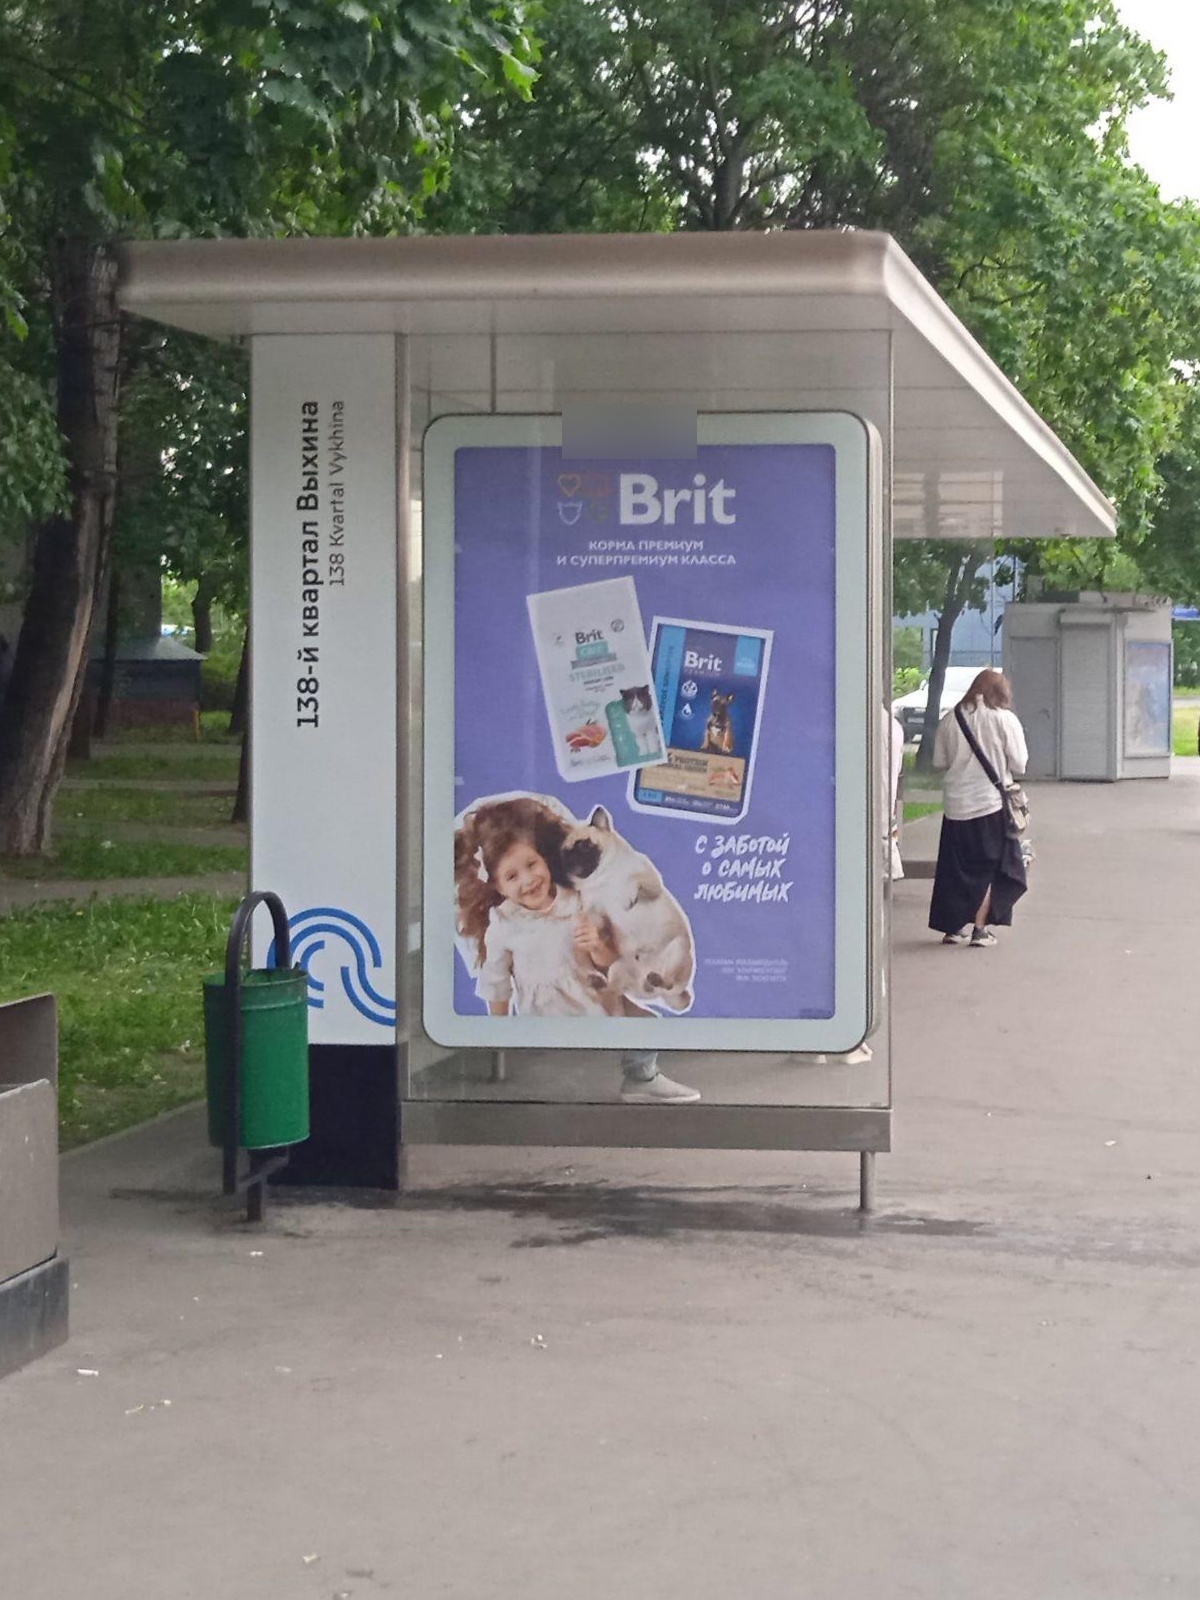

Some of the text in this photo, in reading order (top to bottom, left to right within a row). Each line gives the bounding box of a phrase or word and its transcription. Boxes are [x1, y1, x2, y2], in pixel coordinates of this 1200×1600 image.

[328, 401, 348, 586] 138 Kvartal Vykhina
[619, 473, 737, 525] Brit
[589, 540, 704, 553] КОРМА ПРЕМИУМ
[296, 401, 324, 728] 138-й квартал Выхина
[556, 554, 737, 568] И СУПЕРПРЕМИУМ КЛАССА
[575, 628, 604, 644] Brit
[684, 650, 723, 672] Brit
[718, 856, 786, 879] САМЫХ
